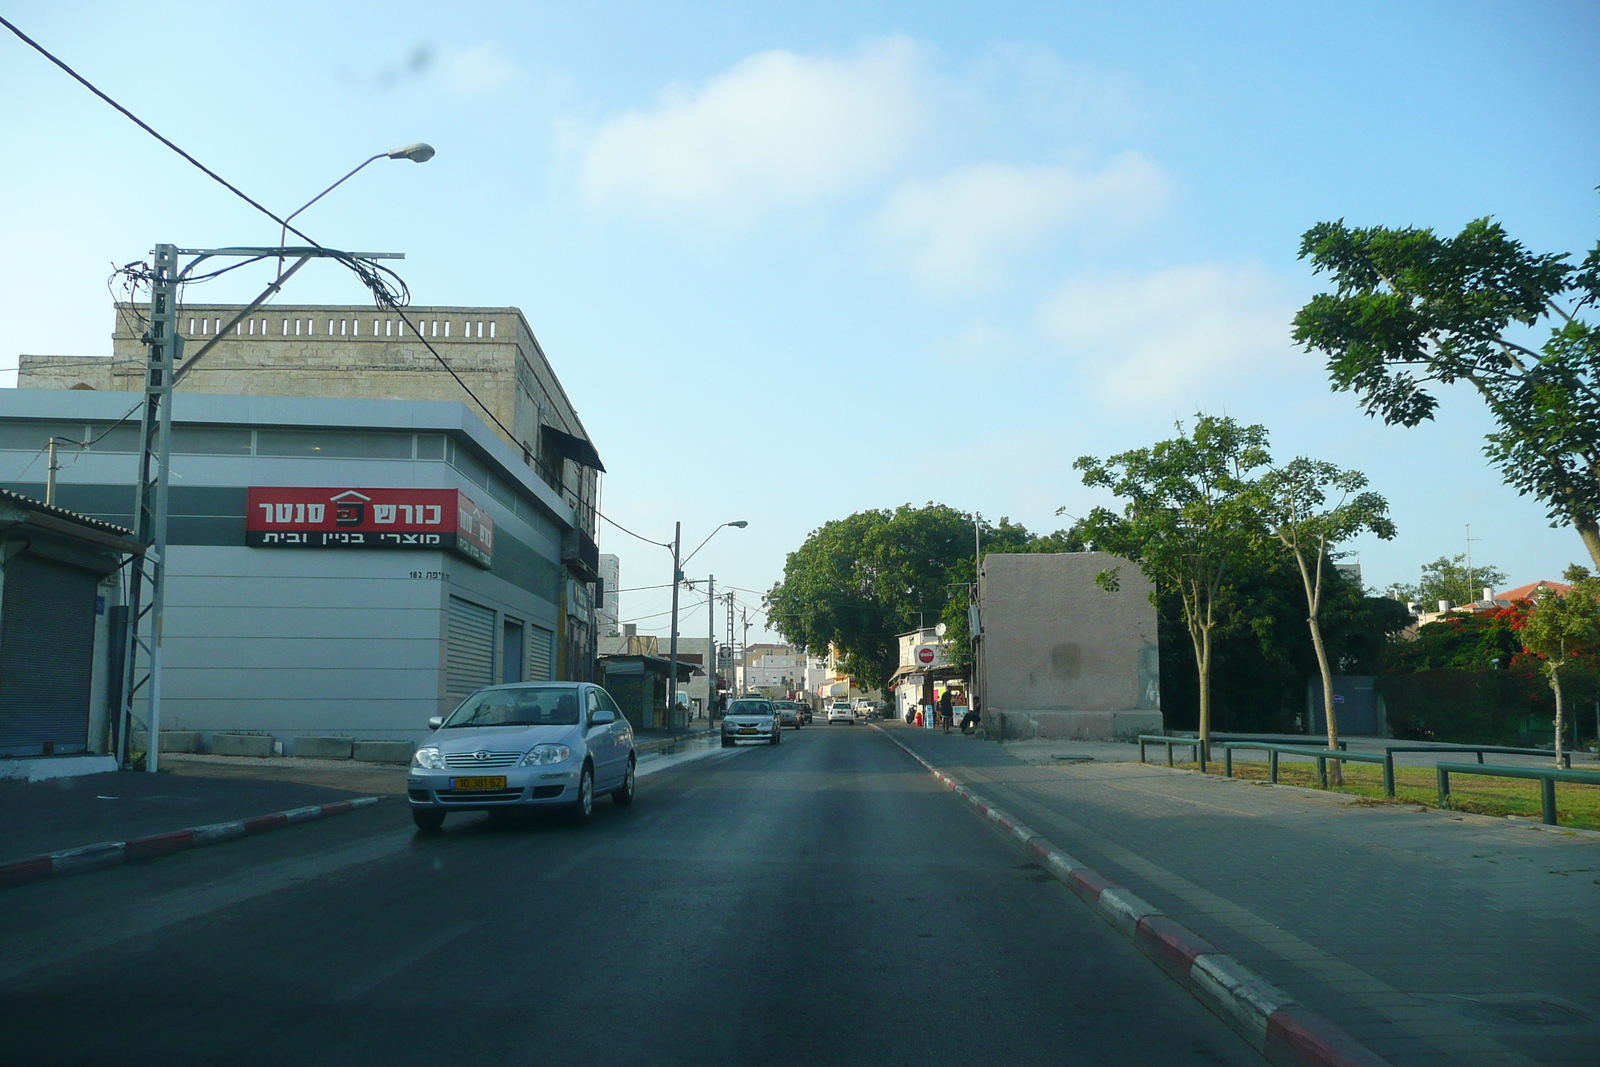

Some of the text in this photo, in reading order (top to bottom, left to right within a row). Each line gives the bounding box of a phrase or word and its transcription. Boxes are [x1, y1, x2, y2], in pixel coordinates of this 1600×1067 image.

[259, 503, 326, 524] סנטר
[373, 504, 442, 525] כורש
[263, 532, 441, 546] מוצרי בניין ובית
[410, 571, 422, 579] 182
